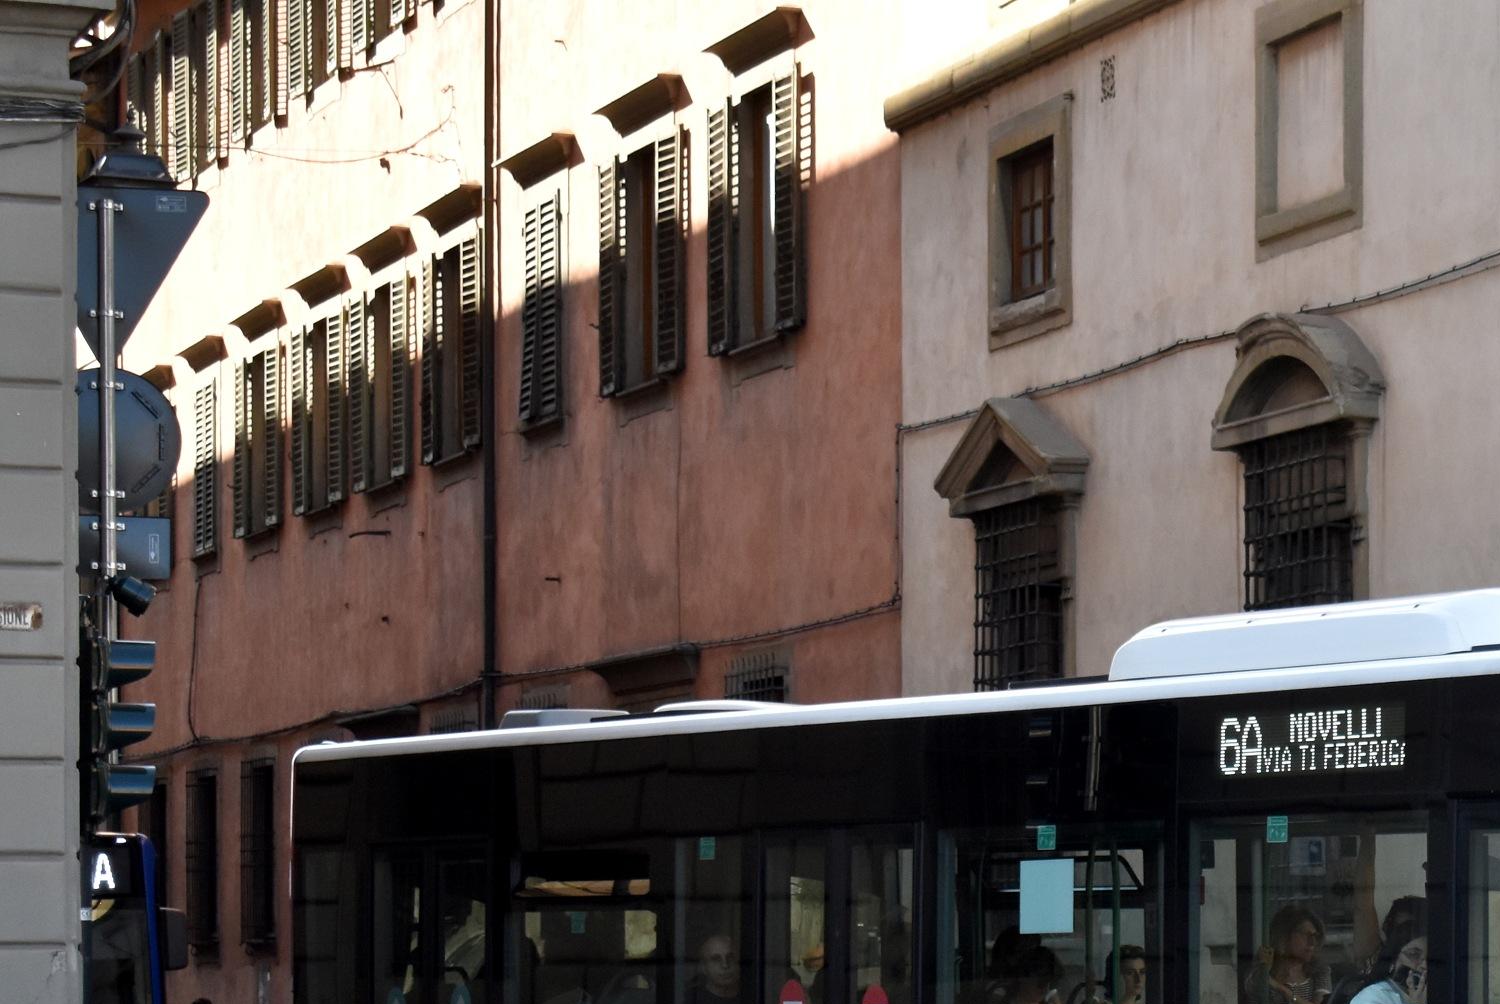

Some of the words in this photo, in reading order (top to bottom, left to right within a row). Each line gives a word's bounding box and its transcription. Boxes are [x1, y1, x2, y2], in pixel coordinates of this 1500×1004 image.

[1289, 707, 1382, 743] NOVELLI
[1220, 716, 1263, 775] 6A
[1263, 746, 1292, 773] VIA
[92, 853, 116, 890] A
